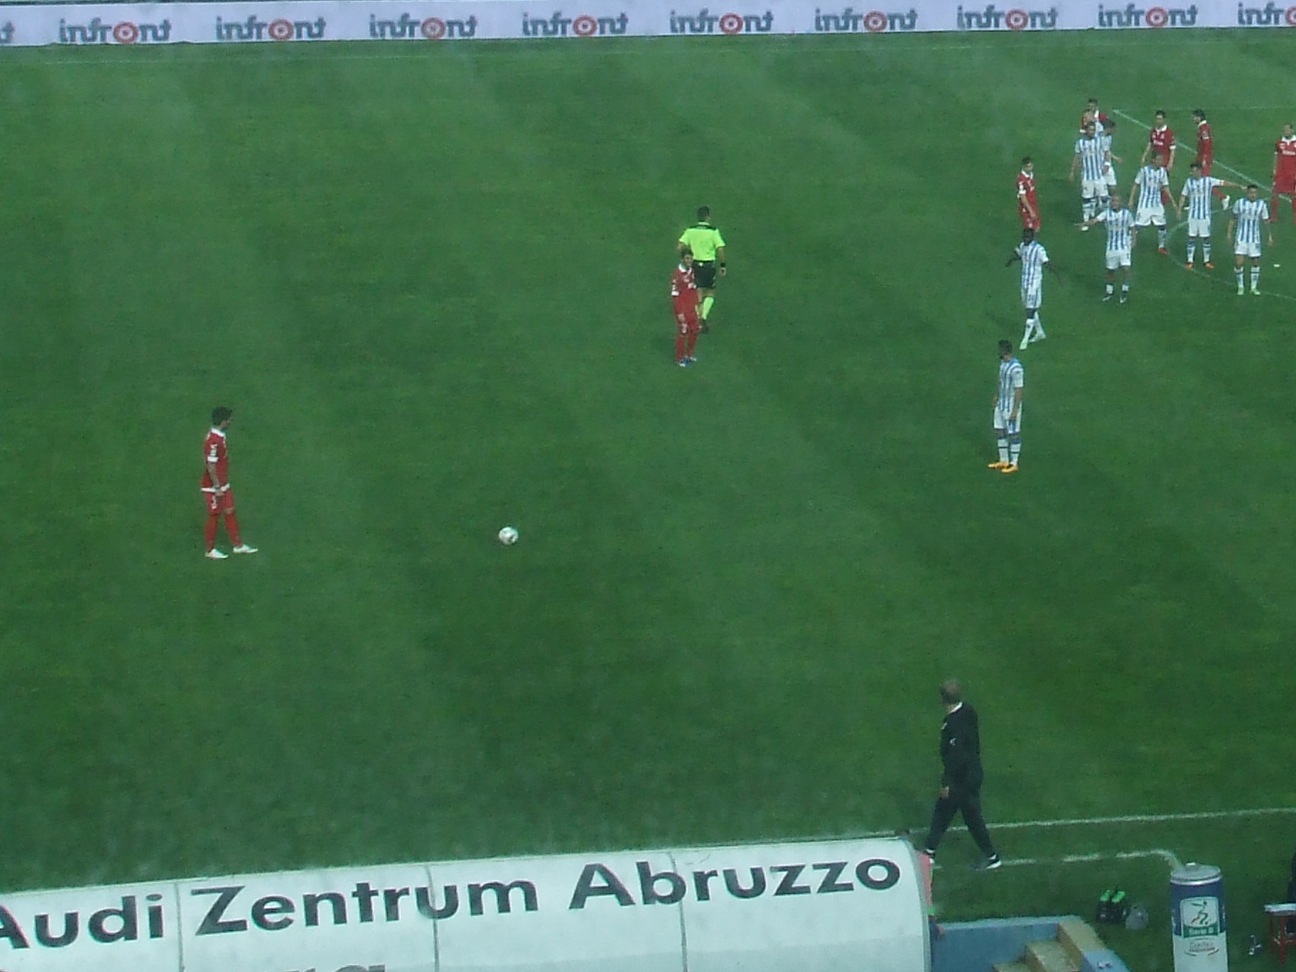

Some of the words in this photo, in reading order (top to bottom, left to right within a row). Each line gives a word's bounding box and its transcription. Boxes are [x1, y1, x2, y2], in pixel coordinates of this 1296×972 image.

[215, 14, 327, 41] infront
[369, 12, 478, 40] infront
[522, 11, 628, 37] infront
[670, 8, 774, 35] infront
[814, 7, 918, 32] infront
[956, 5, 1058, 31] infront
[1098, 3, 1199, 28] infront
[59, 17, 173, 44] infront
[0, 893, 165, 950] Audi
[191, 877, 538, 936] Zentrum
[568, 857, 901, 911] Abruzzo
